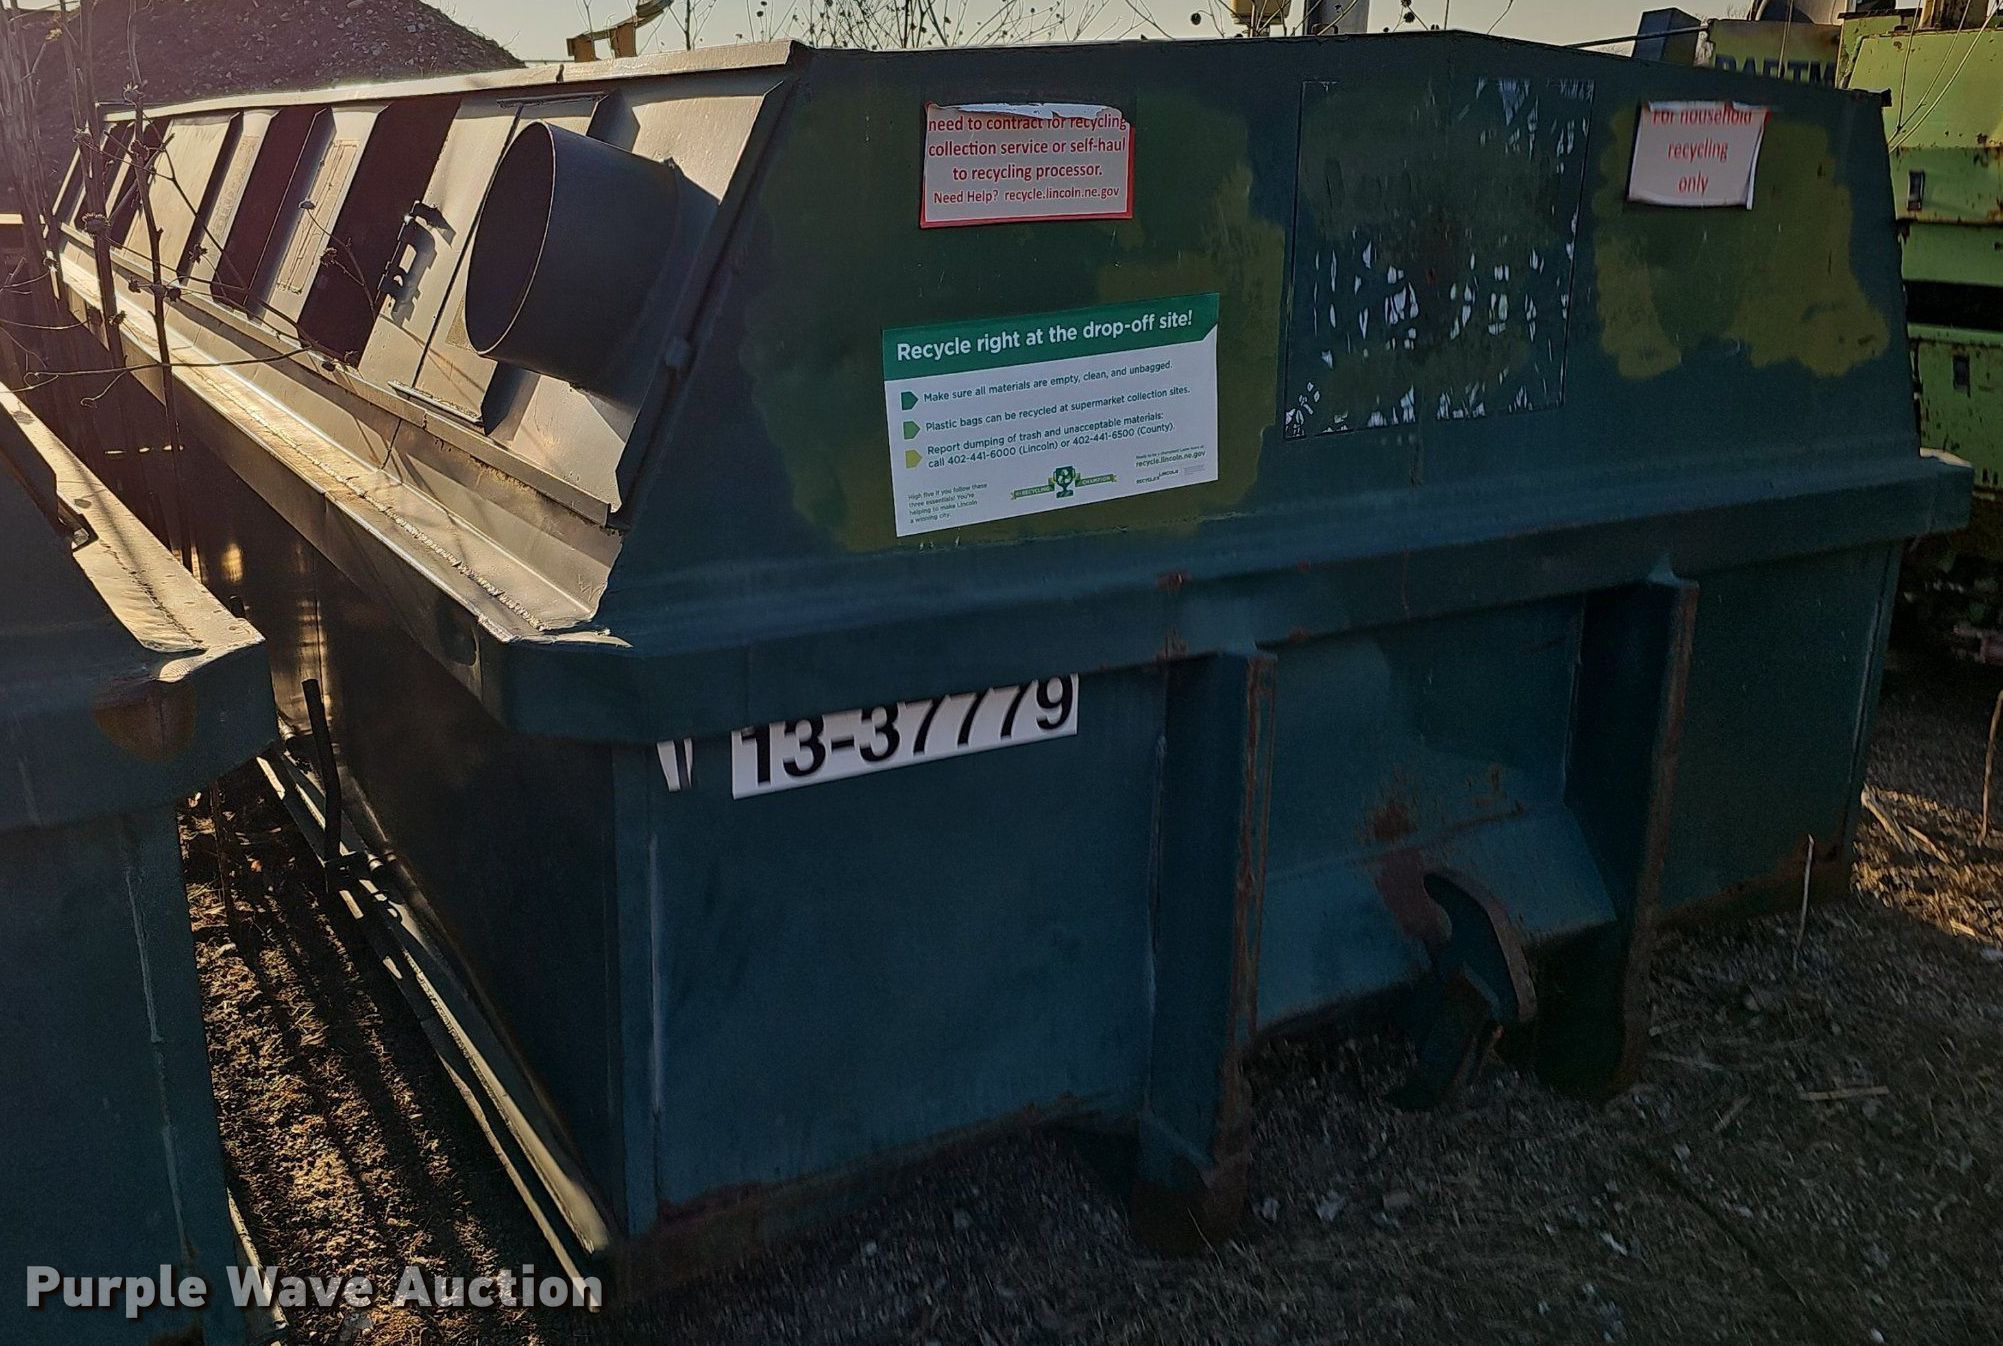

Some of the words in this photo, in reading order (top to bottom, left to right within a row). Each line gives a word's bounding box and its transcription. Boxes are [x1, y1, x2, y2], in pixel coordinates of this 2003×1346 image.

[928, 116, 963, 132] need
[968, 118, 983, 130] to
[986, 117, 1043, 130] contract
[1047, 117, 1067, 129] for
[1069, 113, 1127, 132] recycling
[928, 141, 996, 157] collection
[1000, 140, 1048, 154] service
[1052, 142, 1067, 153] or
[1070, 137, 1126, 152] self-haul
[1667, 138, 1729, 163] recycling
[953, 167, 967, 181] to
[971, 162, 1032, 182] recycling
[1035, 165, 1103, 182] processor.
[1677, 171, 1709, 195] only
[934, 191, 964, 204] Need
[967, 189, 999, 204] Help?
[1004, 187, 1120, 203] recycle.lincoln.ne.gov
[896, 333, 971, 363] Recycle
[976, 329, 1020, 354] right
[1025, 327, 1043, 346] at
[1048, 323, 1078, 342] the
[1082, 313, 1155, 343] drop-off
[1159, 309, 1193, 328] site!
[923, 391, 949, 403] Make
[952, 390, 972, 399] sure
[974, 386, 986, 396] all
[988, 381, 1031, 394] materials
[1033, 379, 1048, 388] are
[1050, 374, 1081, 386] empty,
[1083, 370, 1109, 382] clean,
[1110, 366, 1127, 377] and
[1129, 360, 1173, 375] unbagged.
[926, 419, 957, 431] Plastic
[960, 416, 983, 427] bags
[985, 413, 1002, 423] can
[1004, 410, 1017, 420] be
[1019, 404, 1057, 419] recycled
[1059, 404, 1069, 412] at
[1070, 394, 1125, 410] supermarket
[1127, 388, 1167, 402] collection
[1169, 385, 1190, 396] sites.
[927, 443, 961, 455] Report
[963, 436, 1005, 450] dumping
[1007, 433, 1017, 443] of
[1019, 430, 1042, 442] trash
[1044, 426, 1061, 437] and
[1063, 414, 1122, 434] unacceptable
[1123, 411, 1164, 426] materials:
[928, 457, 945, 468] call
[947, 446, 1016, 464] 402-441-6000
[1018, 440, 1058, 456] (Lincoln)
[1060, 439, 1070, 448] or
[1072, 427, 1135, 446] 402-441-6500
